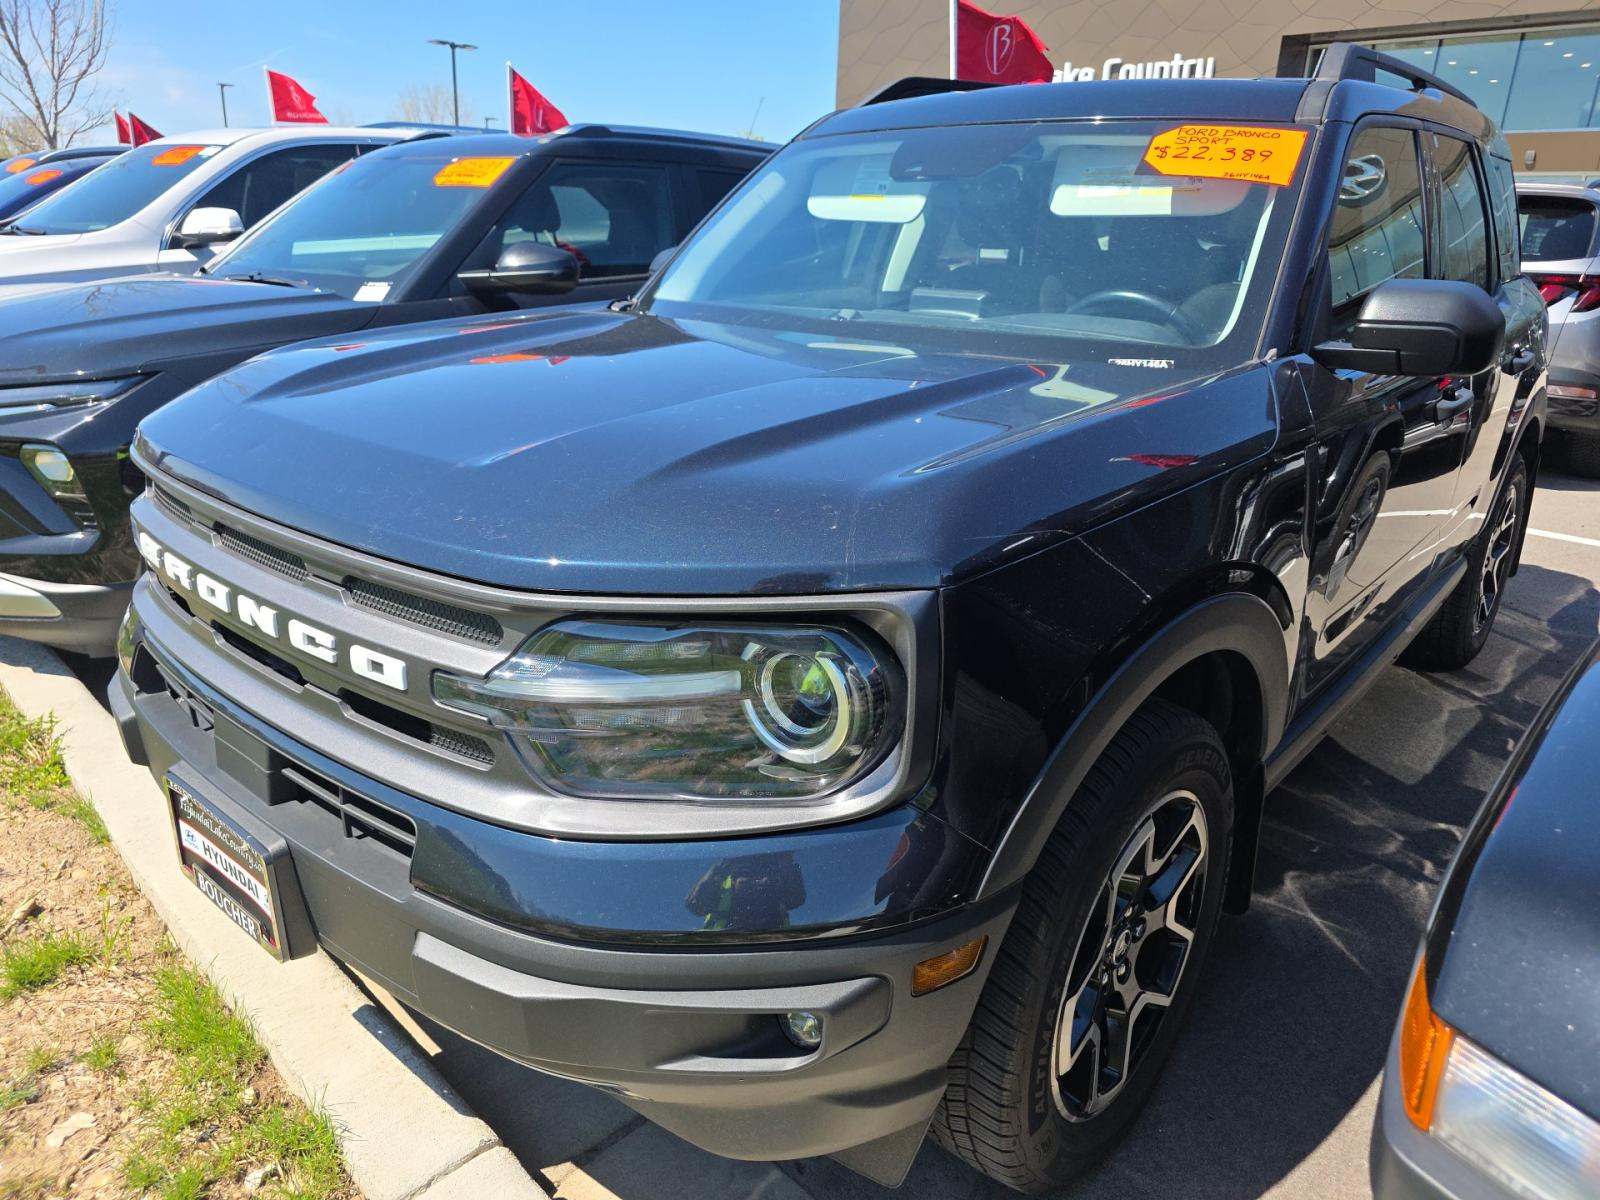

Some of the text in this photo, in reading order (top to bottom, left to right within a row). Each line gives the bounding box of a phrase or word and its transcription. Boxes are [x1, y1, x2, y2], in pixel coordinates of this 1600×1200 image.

[1053, 53, 1215, 83] ake Country
[1175, 137, 1232, 145] SPORT
[1178, 127, 1281, 139] FORD BRONCO
[1154, 145, 1273, 163] $22,389
[139, 532, 408, 691] BRONCO
[202, 840, 260, 899] HYUNDAI
[198, 873, 257, 939] BOUCHER
